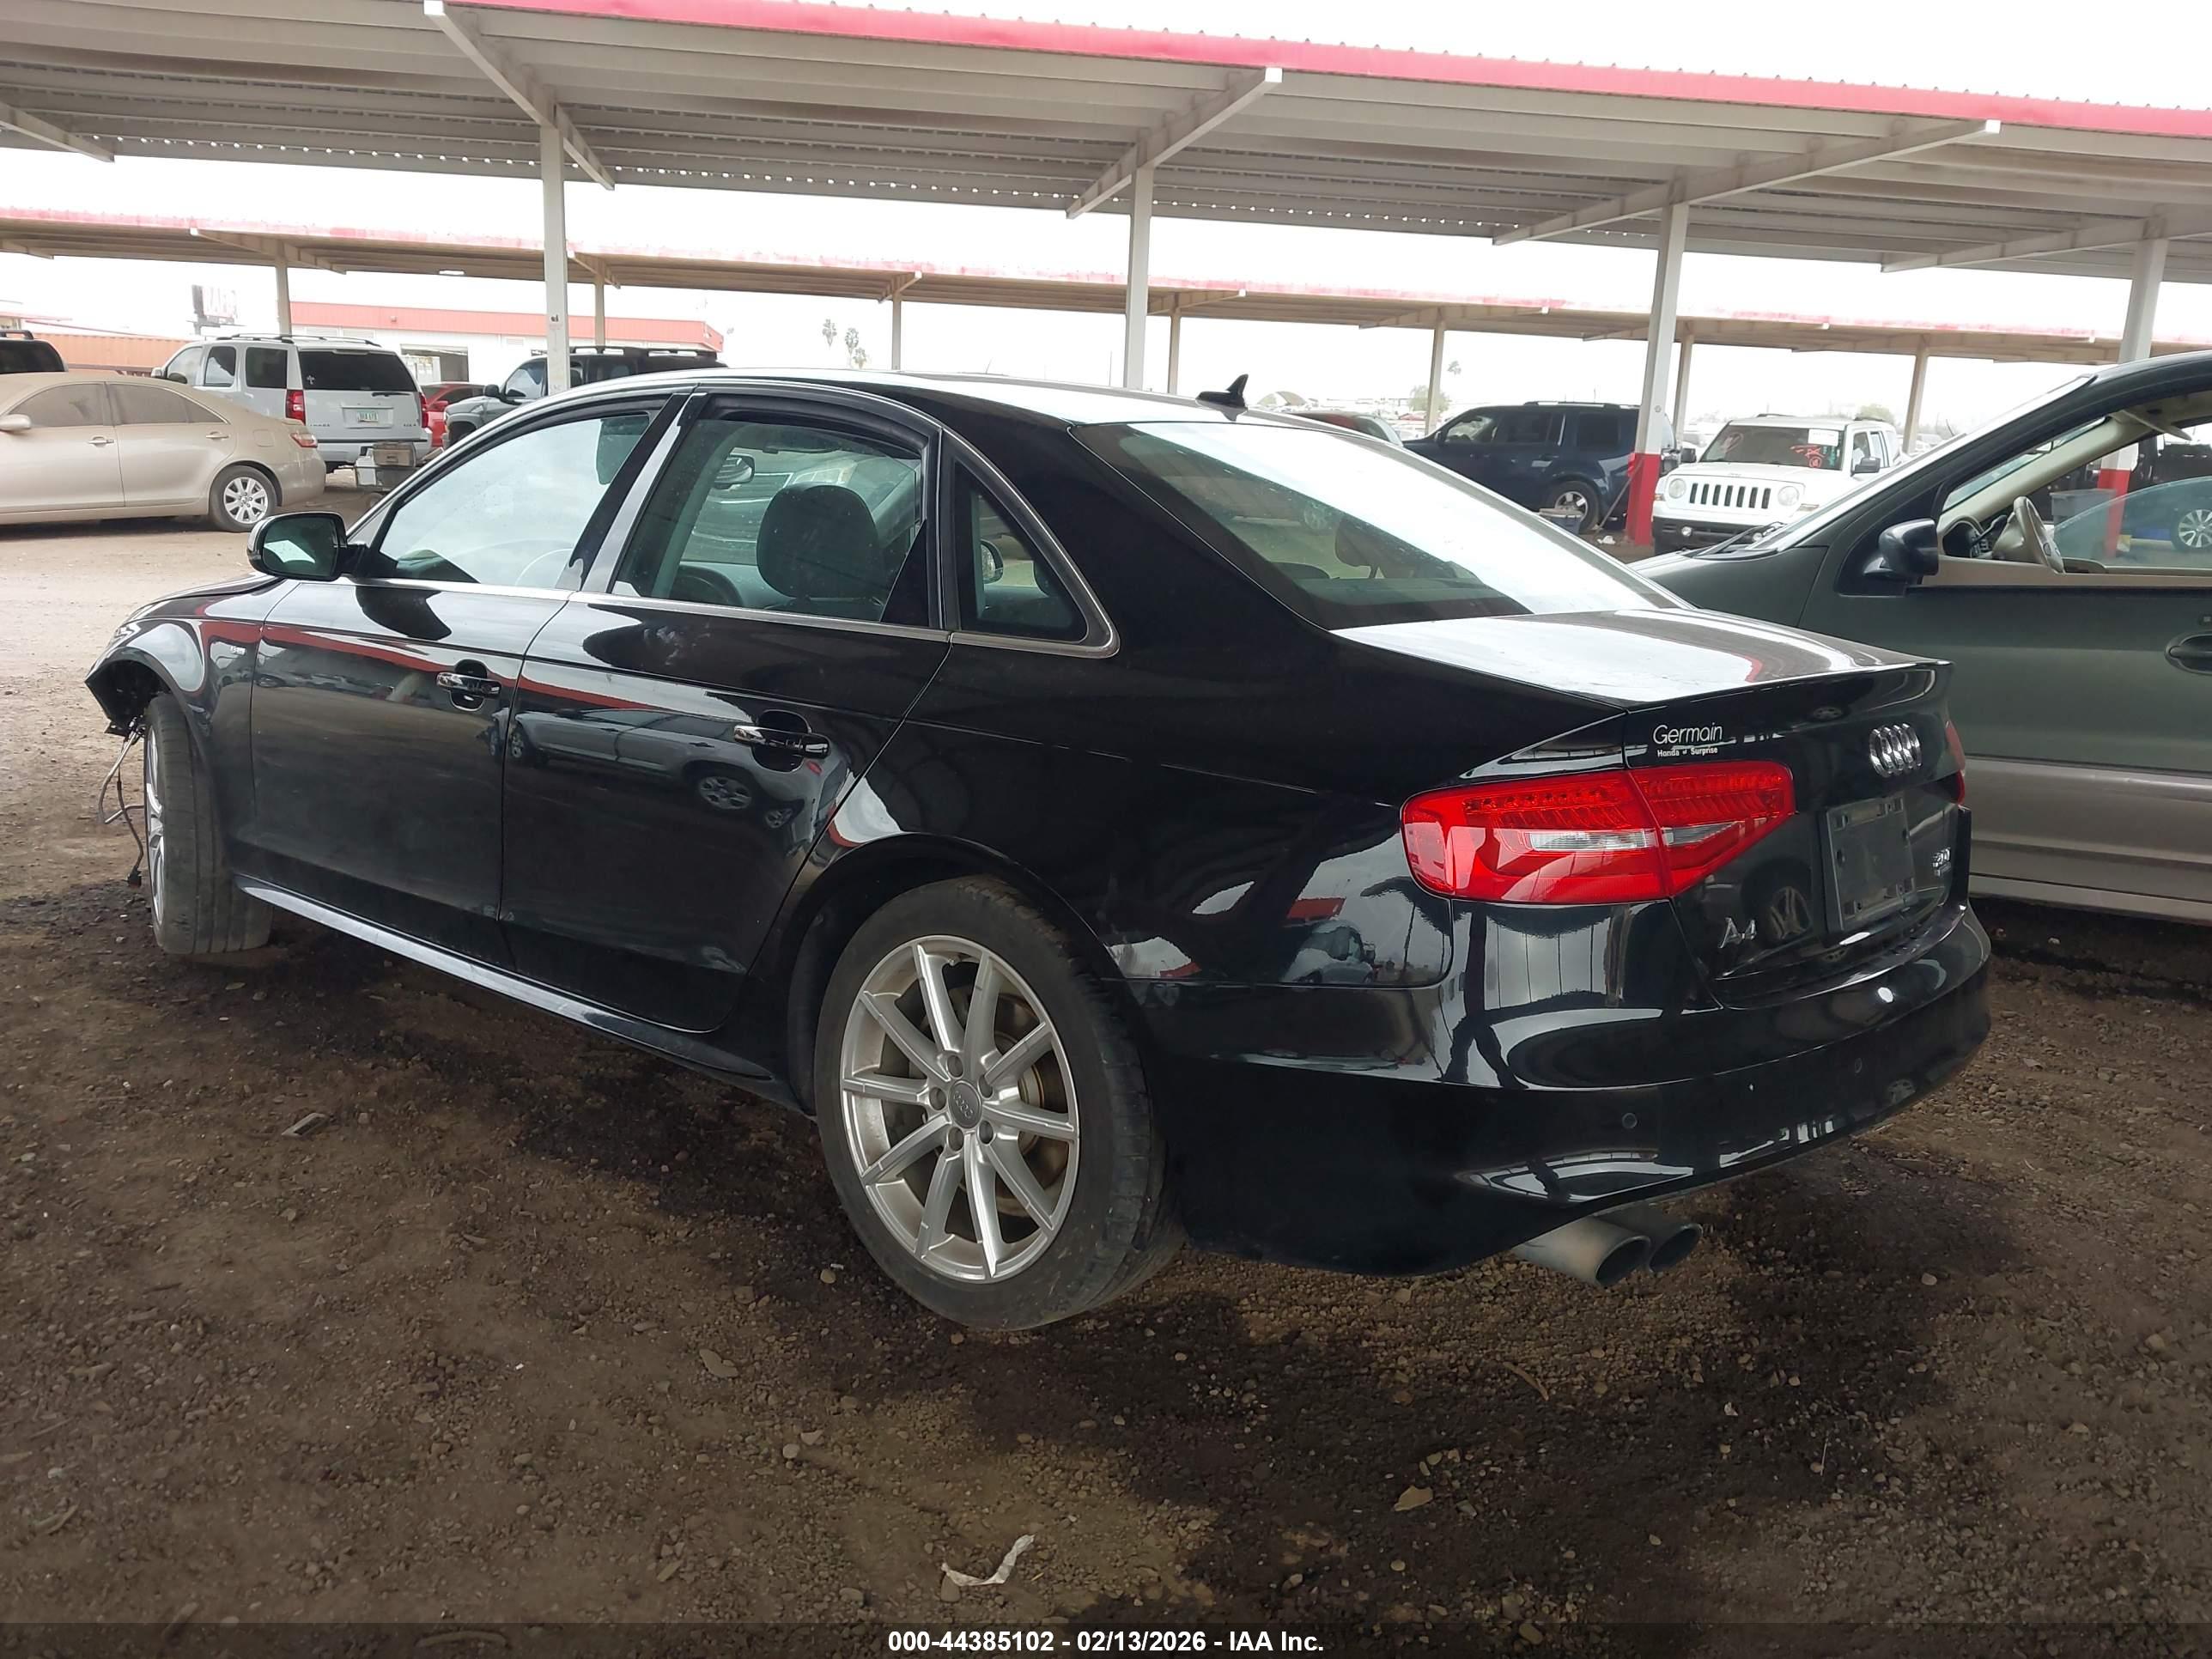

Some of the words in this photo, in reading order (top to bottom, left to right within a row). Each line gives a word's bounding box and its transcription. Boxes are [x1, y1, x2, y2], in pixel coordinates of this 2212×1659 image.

[1653, 722, 1723, 744] Germain
[1656, 749, 1680, 757] Honda
[1690, 746, 1718, 757] Surprise
[1717, 916, 1757, 949] A4
